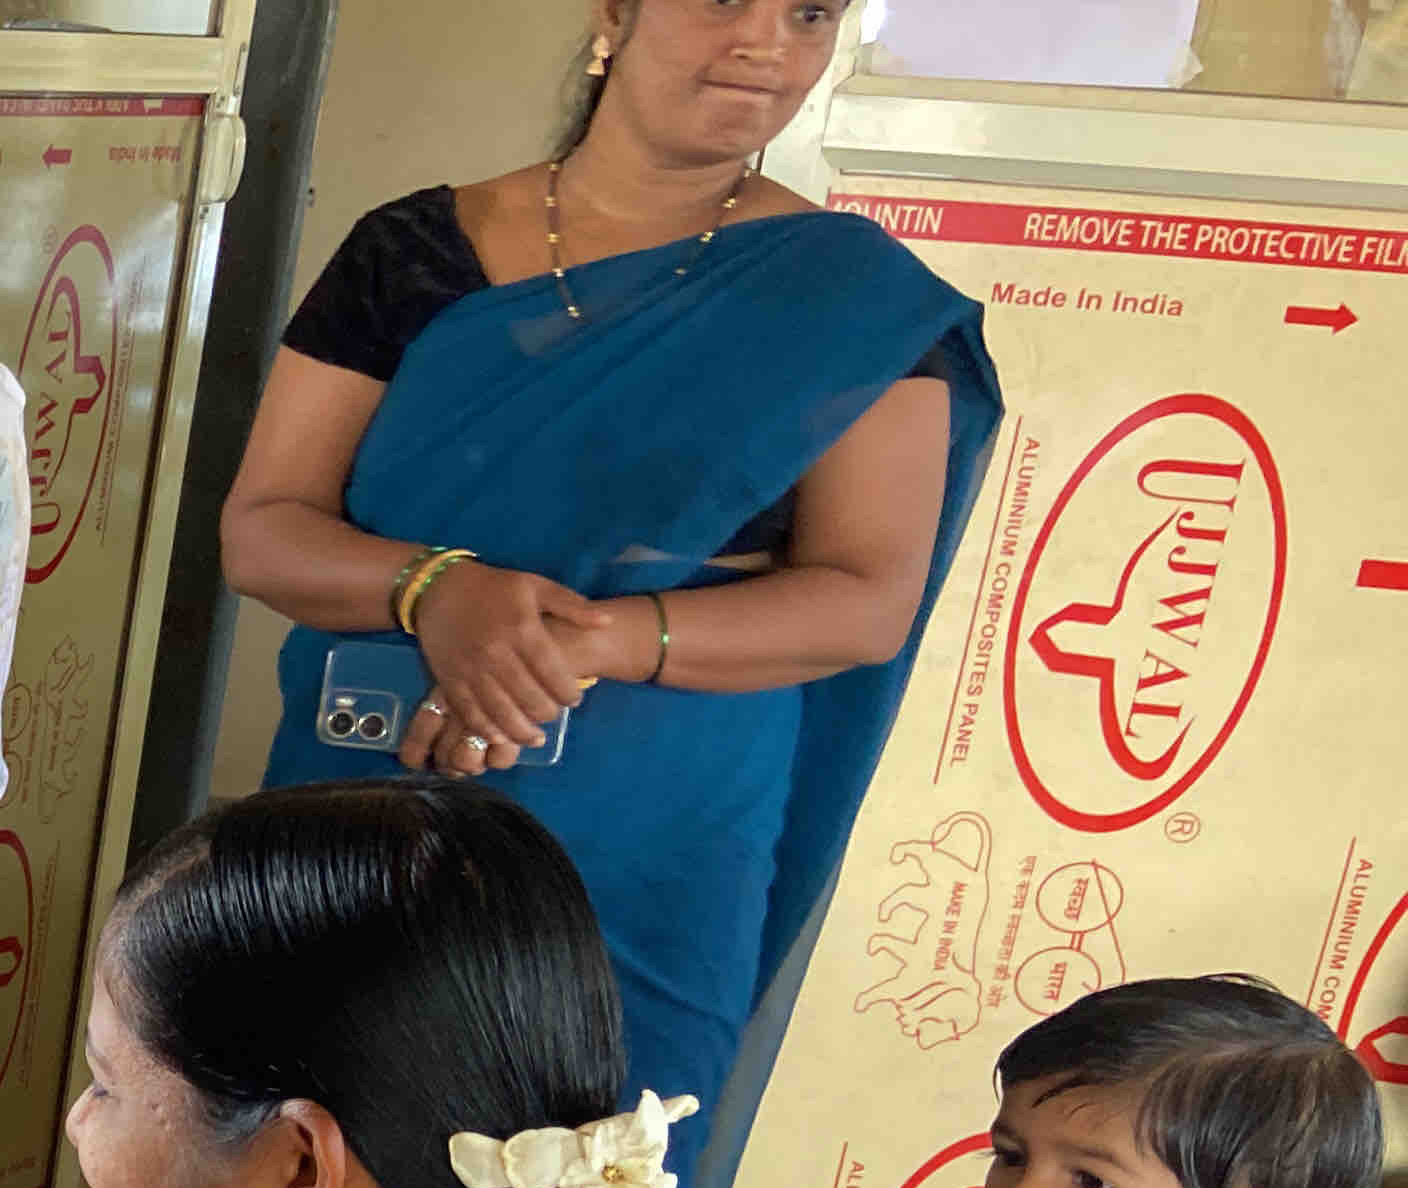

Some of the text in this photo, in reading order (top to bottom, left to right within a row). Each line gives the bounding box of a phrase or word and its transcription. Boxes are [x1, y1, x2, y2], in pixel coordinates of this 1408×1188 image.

[1023, 213, 1135, 247] REMOVE
[1141, 220, 1191, 250] THE
[1193, 225, 1356, 263] PROTECTIVE
[991, 283, 1184, 317] Made In India
[950, 437, 1040, 767] ALUMINIUM COMPOSITES PANEL
[1125, 458, 1246, 739] UJJWAL
[933, 881, 968, 971] MAKE IN INDIA
[1327, 858, 1373, 971] ALUMINIUM
